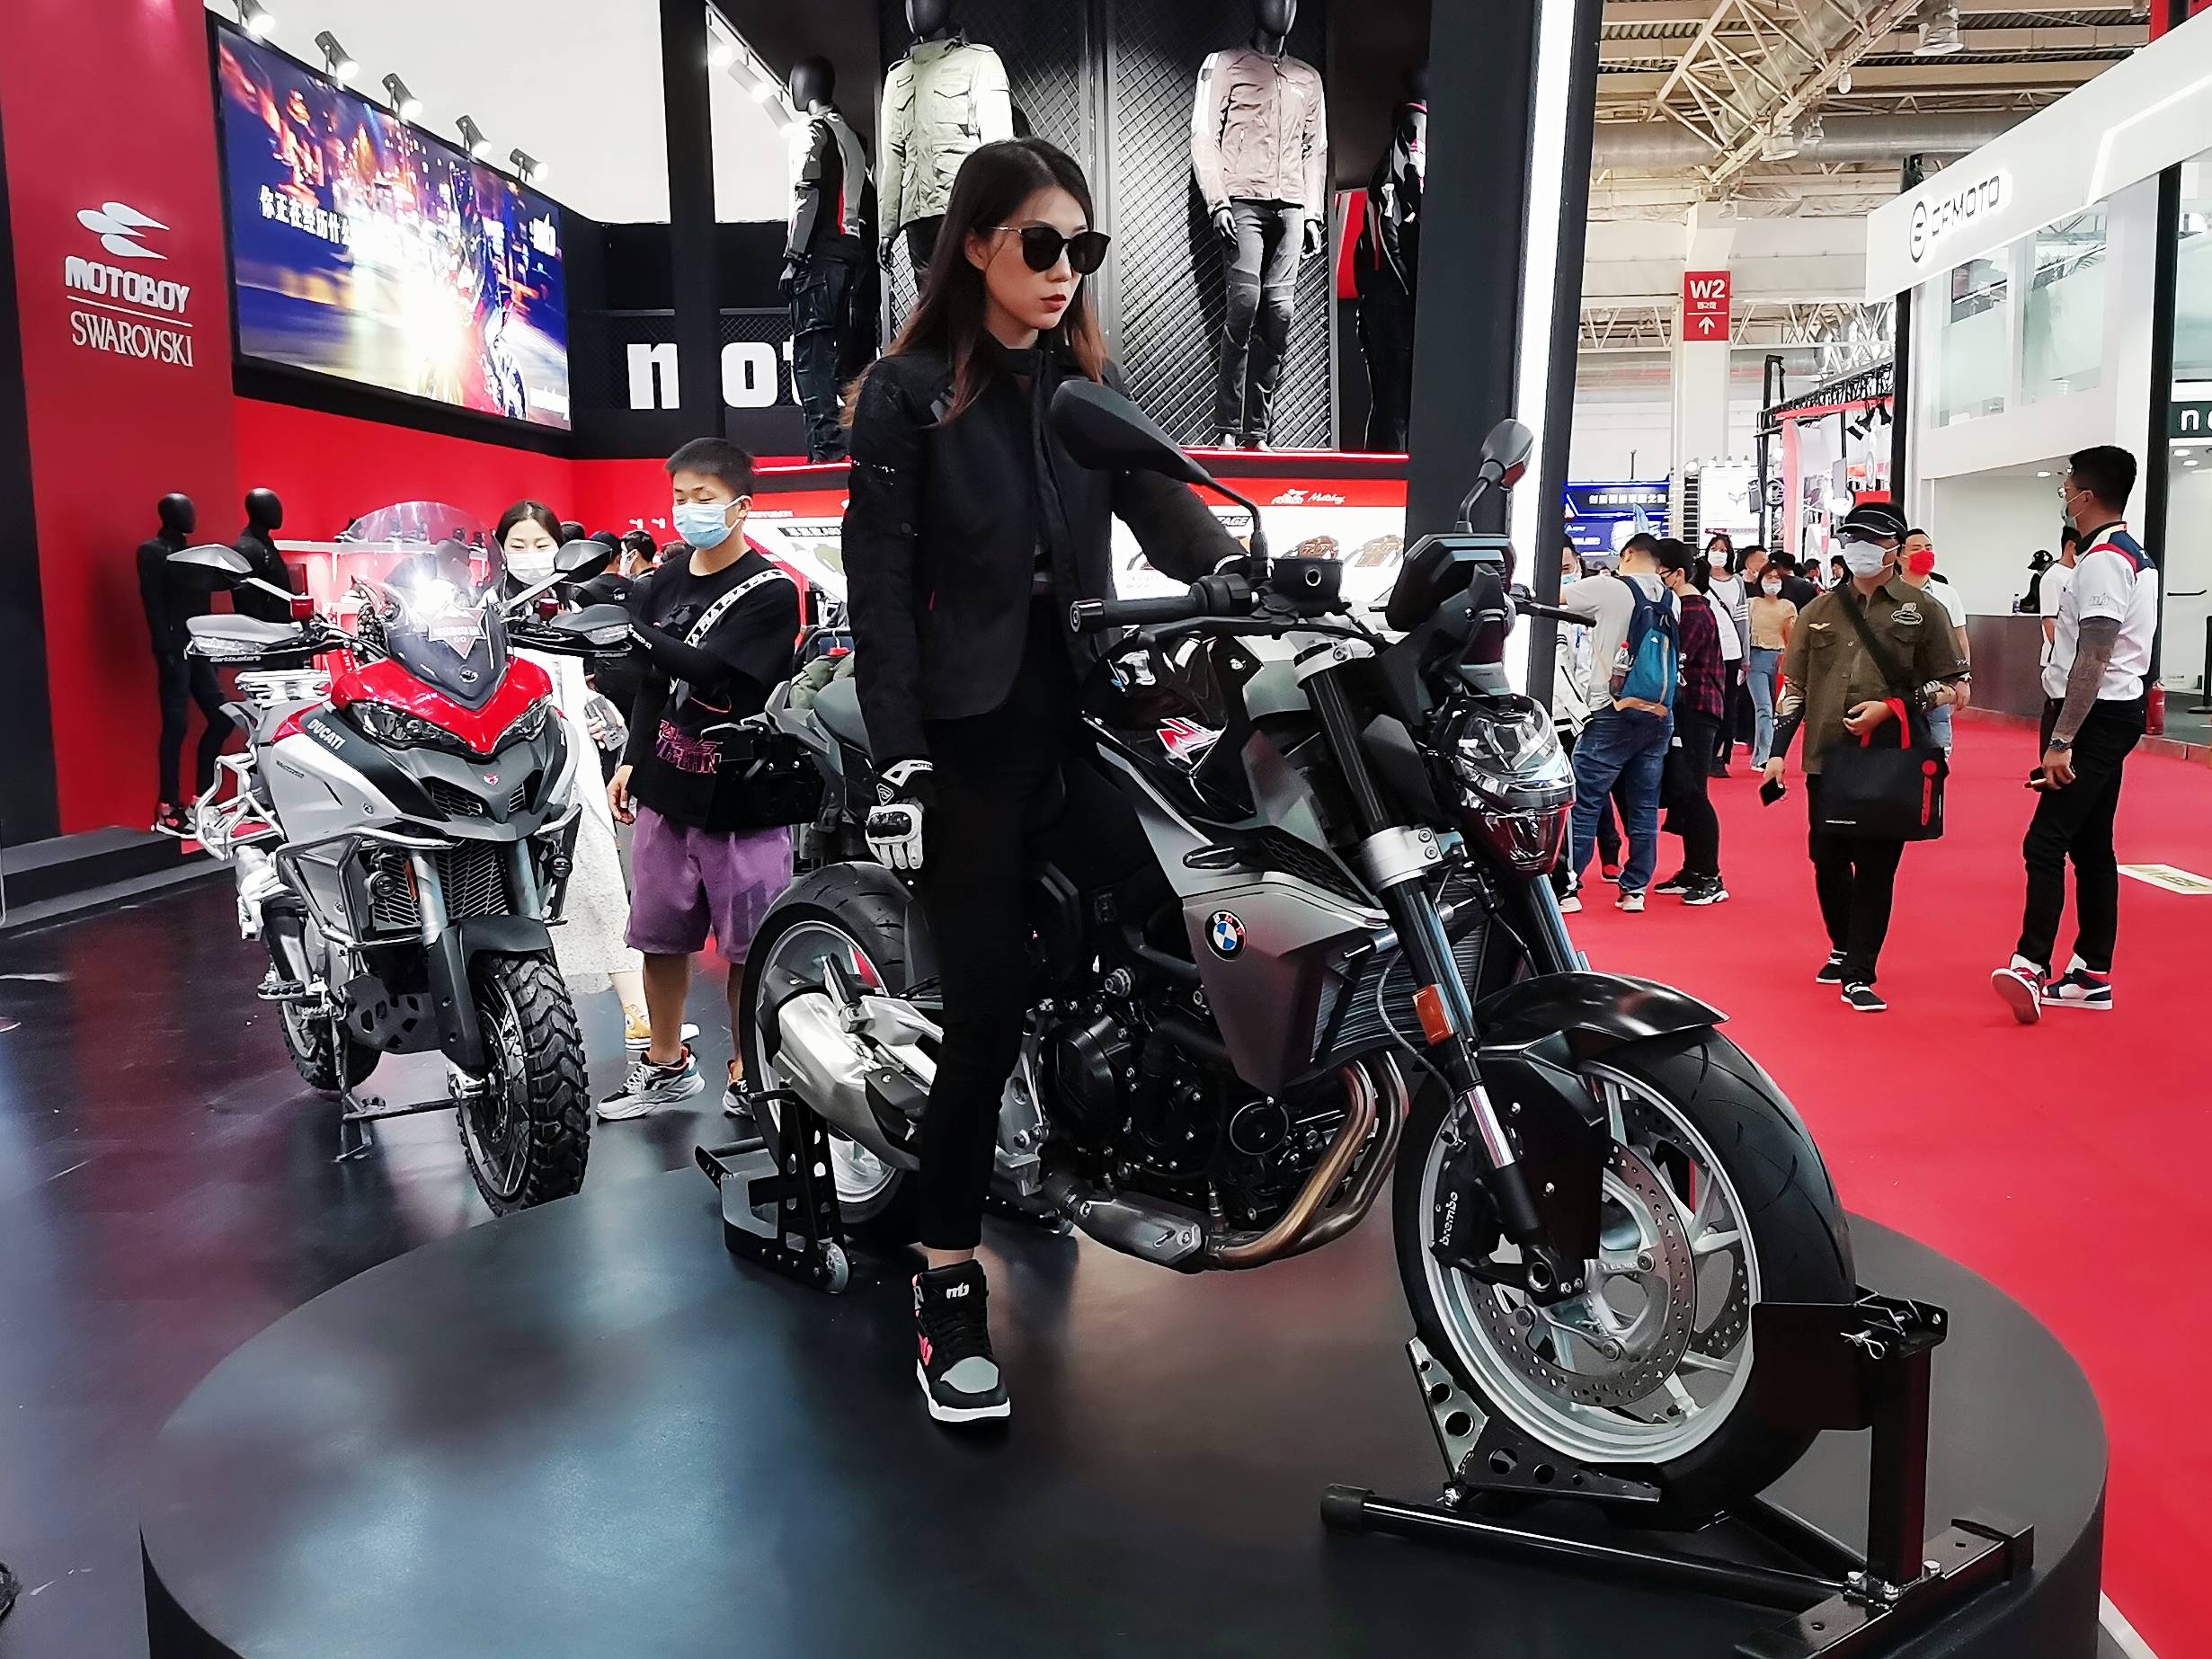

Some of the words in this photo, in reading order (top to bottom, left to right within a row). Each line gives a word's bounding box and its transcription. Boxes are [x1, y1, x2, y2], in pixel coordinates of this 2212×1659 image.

[1932, 175, 2000, 236] CFMOTO
[66, 255, 191, 314] MOTOBOY
[1689, 279, 1727, 299] W2
[70, 310, 194, 368] SWAROVSKI
[306, 718, 346, 750] DUCATI
[1439, 1191, 1459, 1246] brembo
